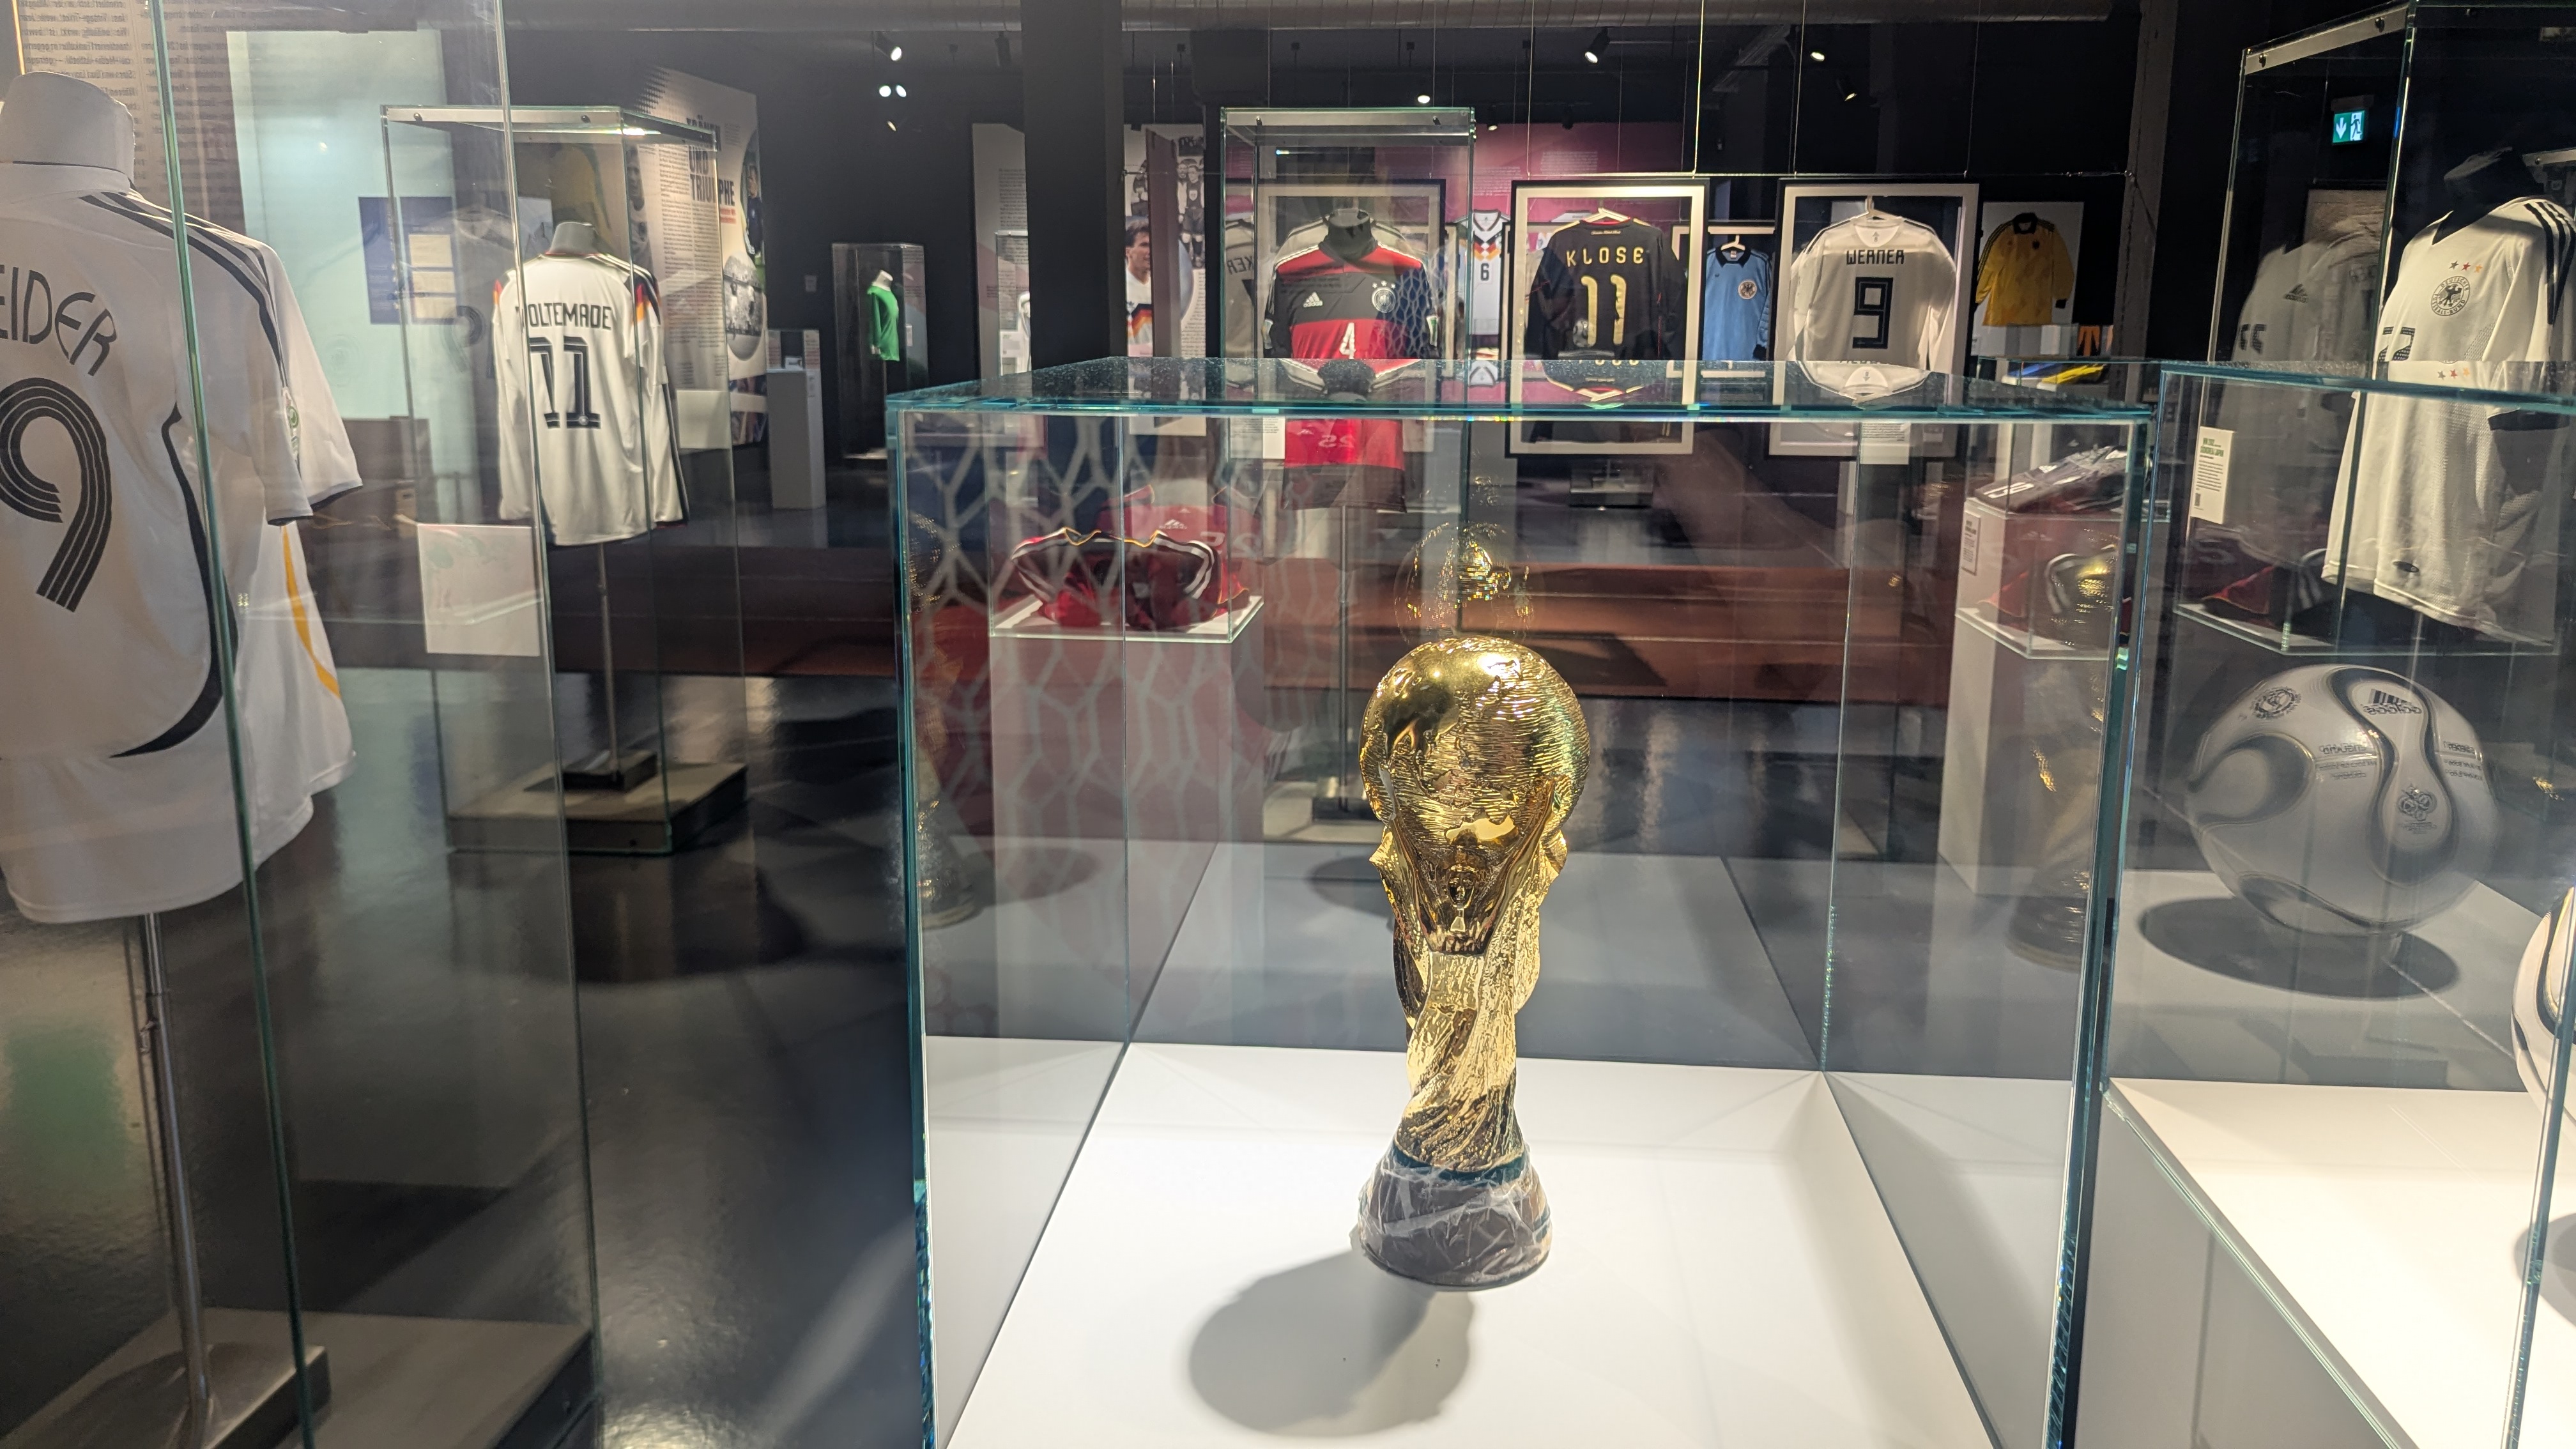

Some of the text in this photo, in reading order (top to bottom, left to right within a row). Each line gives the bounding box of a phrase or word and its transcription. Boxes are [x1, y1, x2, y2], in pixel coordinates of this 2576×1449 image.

[1480, 263, 1489, 281] 6
[1565, 245, 1644, 268] KLOSE
[1846, 249, 1905, 265] WERNER
[515, 302, 612, 330] OLTEMADE
[1580, 273, 1627, 347] 11
[1852, 277, 1894, 349] 9
[1338, 321, 1356, 360] 4
[528, 335, 601, 429] 11
[0, 376, 112, 612] 9
